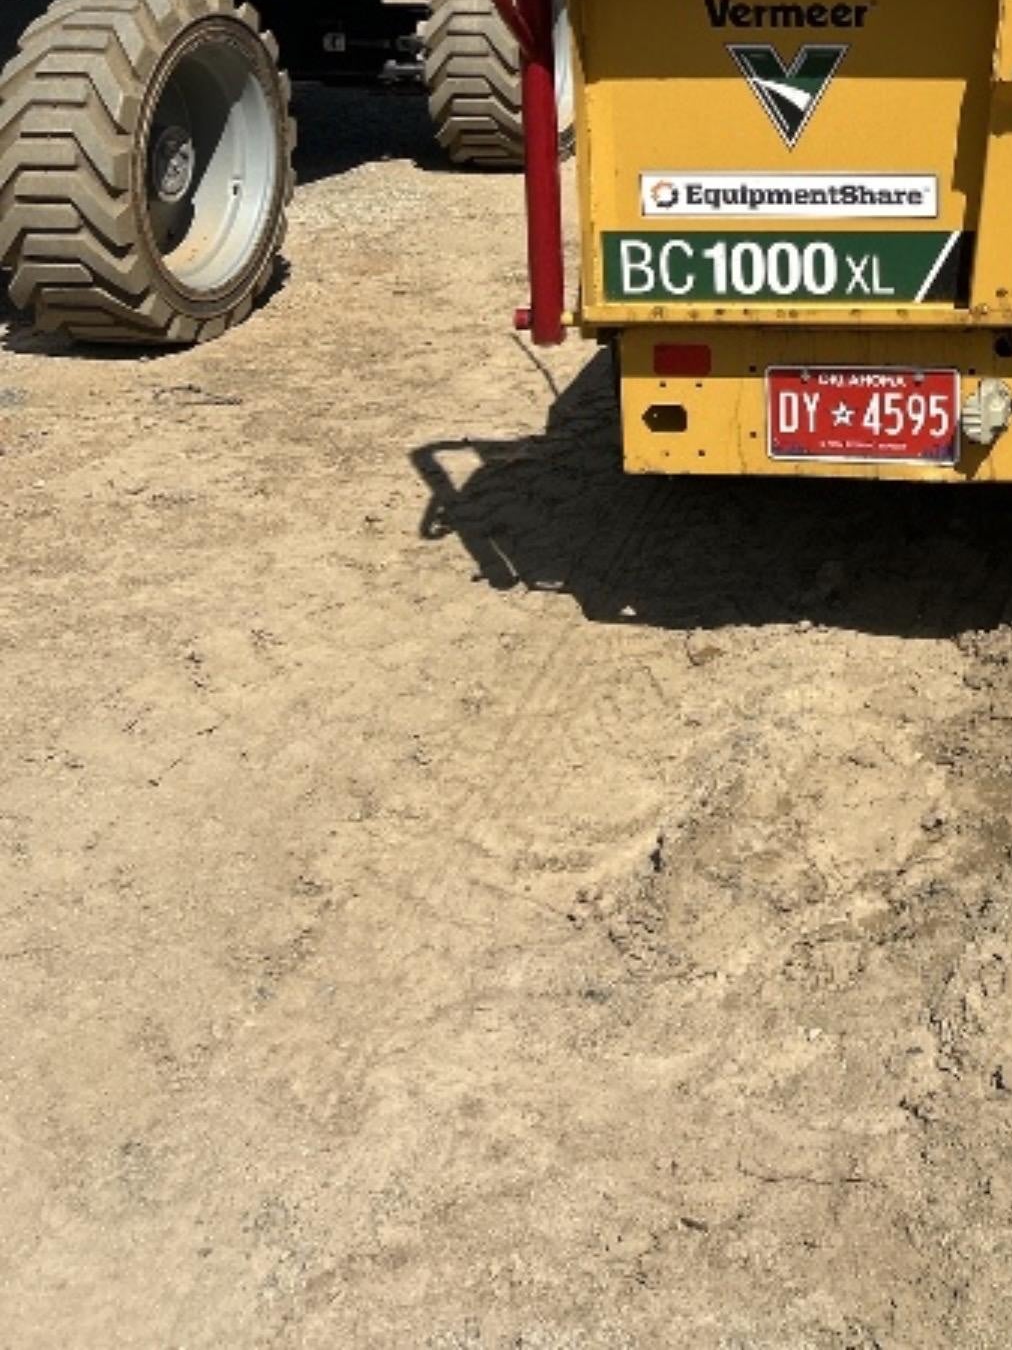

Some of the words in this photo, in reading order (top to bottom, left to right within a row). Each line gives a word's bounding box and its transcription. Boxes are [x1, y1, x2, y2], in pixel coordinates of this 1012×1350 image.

[685, 183, 923, 209] EquipmentShare
[620, 239, 695, 295] BC
[703, 241, 838, 295] 1000
[845, 253, 895, 295] XL
[779, 392, 820, 433] DY
[862, 393, 949, 437] 4595
